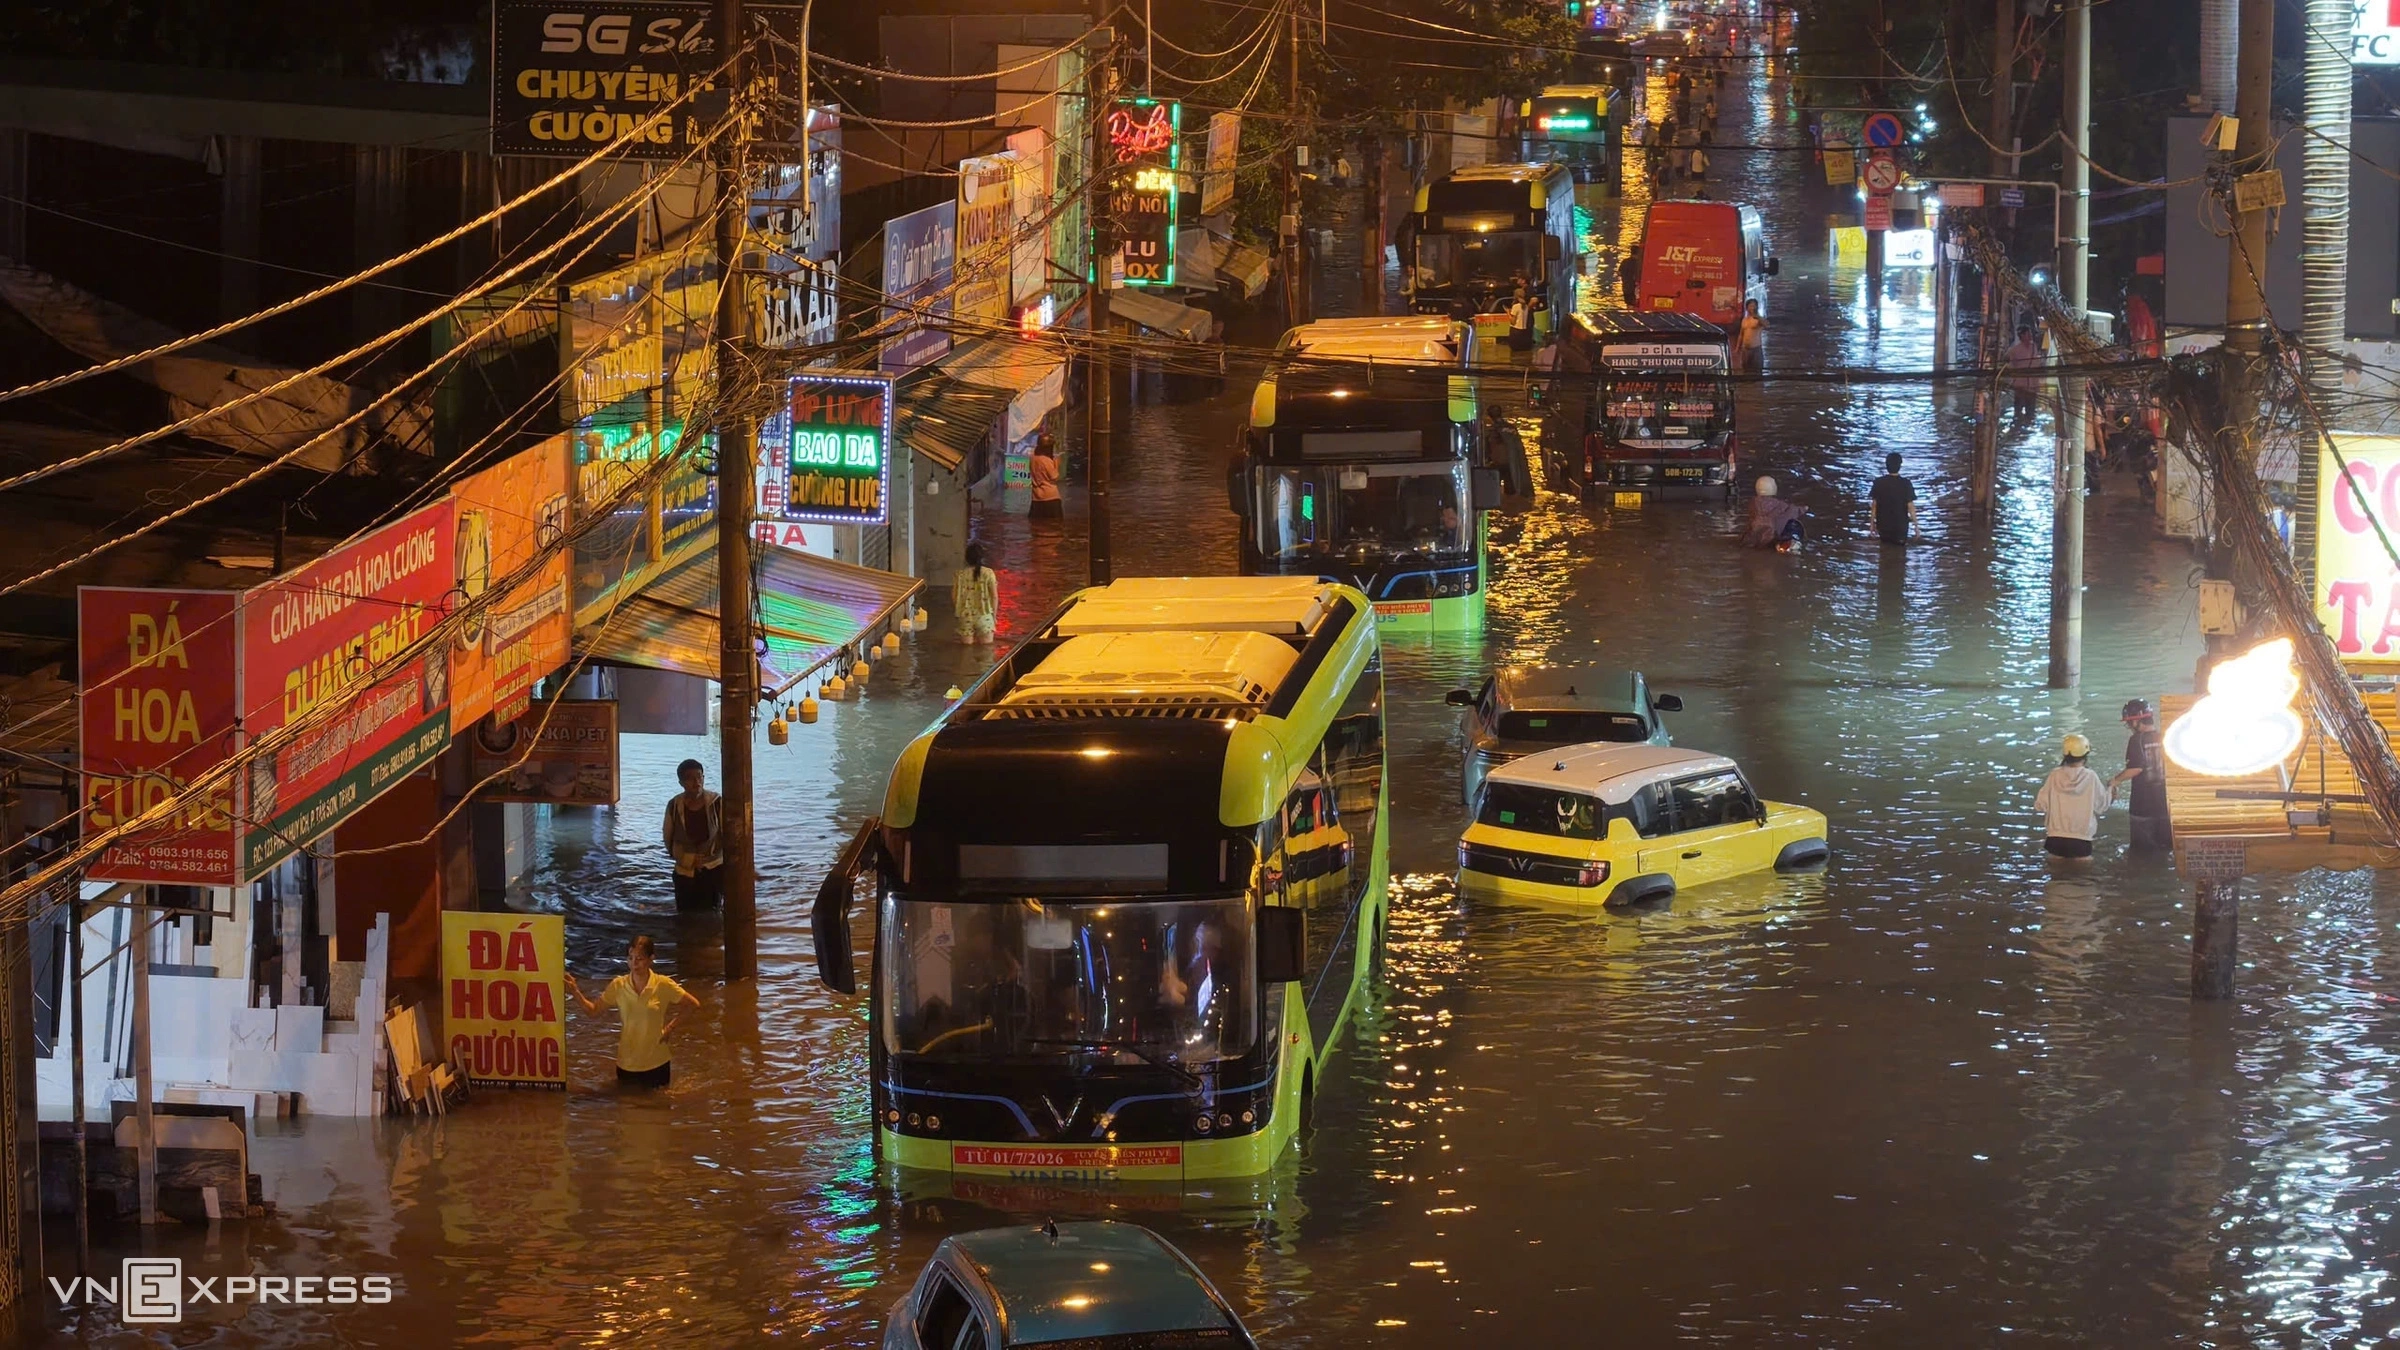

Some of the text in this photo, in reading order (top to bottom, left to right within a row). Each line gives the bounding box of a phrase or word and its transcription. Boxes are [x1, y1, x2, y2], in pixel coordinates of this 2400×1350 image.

[540, 13, 632, 55] SG
[2351, 35, 2390, 58] FC
[516, 65, 678, 102] CHUYÊN
[530, 104, 674, 145] CƯỜNG
[1125, 241, 1156, 257] LU
[1658, 246, 1701, 262] J&T
[1692, 255, 1723, 264] EXPRESS
[1126, 263, 1160, 279] OX
[826, 393, 884, 427] LƯNG
[794, 431, 841, 465] BAO
[845, 434, 877, 467] DA
[789, 469, 846, 507] CƯỜNG
[849, 475, 881, 514] LỰC
[271, 527, 436, 644] CỬA HÀNG ĐÁ HOA CƯƠNG
[127, 600, 189, 669] ĐÁ
[284, 632, 364, 723] QUANG
[369, 597, 424, 670] PHÁT
[114, 687, 201, 744] HOA
[522, 727, 608, 741] NKA PET
[87, 766, 232, 833] CƯƠNG
[149, 846, 230, 860] 0903.918.656
[467, 922, 540, 972] ĐÁ
[451, 979, 557, 1023] HOA
[452, 1029, 560, 1077] CƯƠNG
[964, 1147, 1064, 1165] TỪ 01/7/2026
[1130, 1157, 1168, 1165] TICKET
